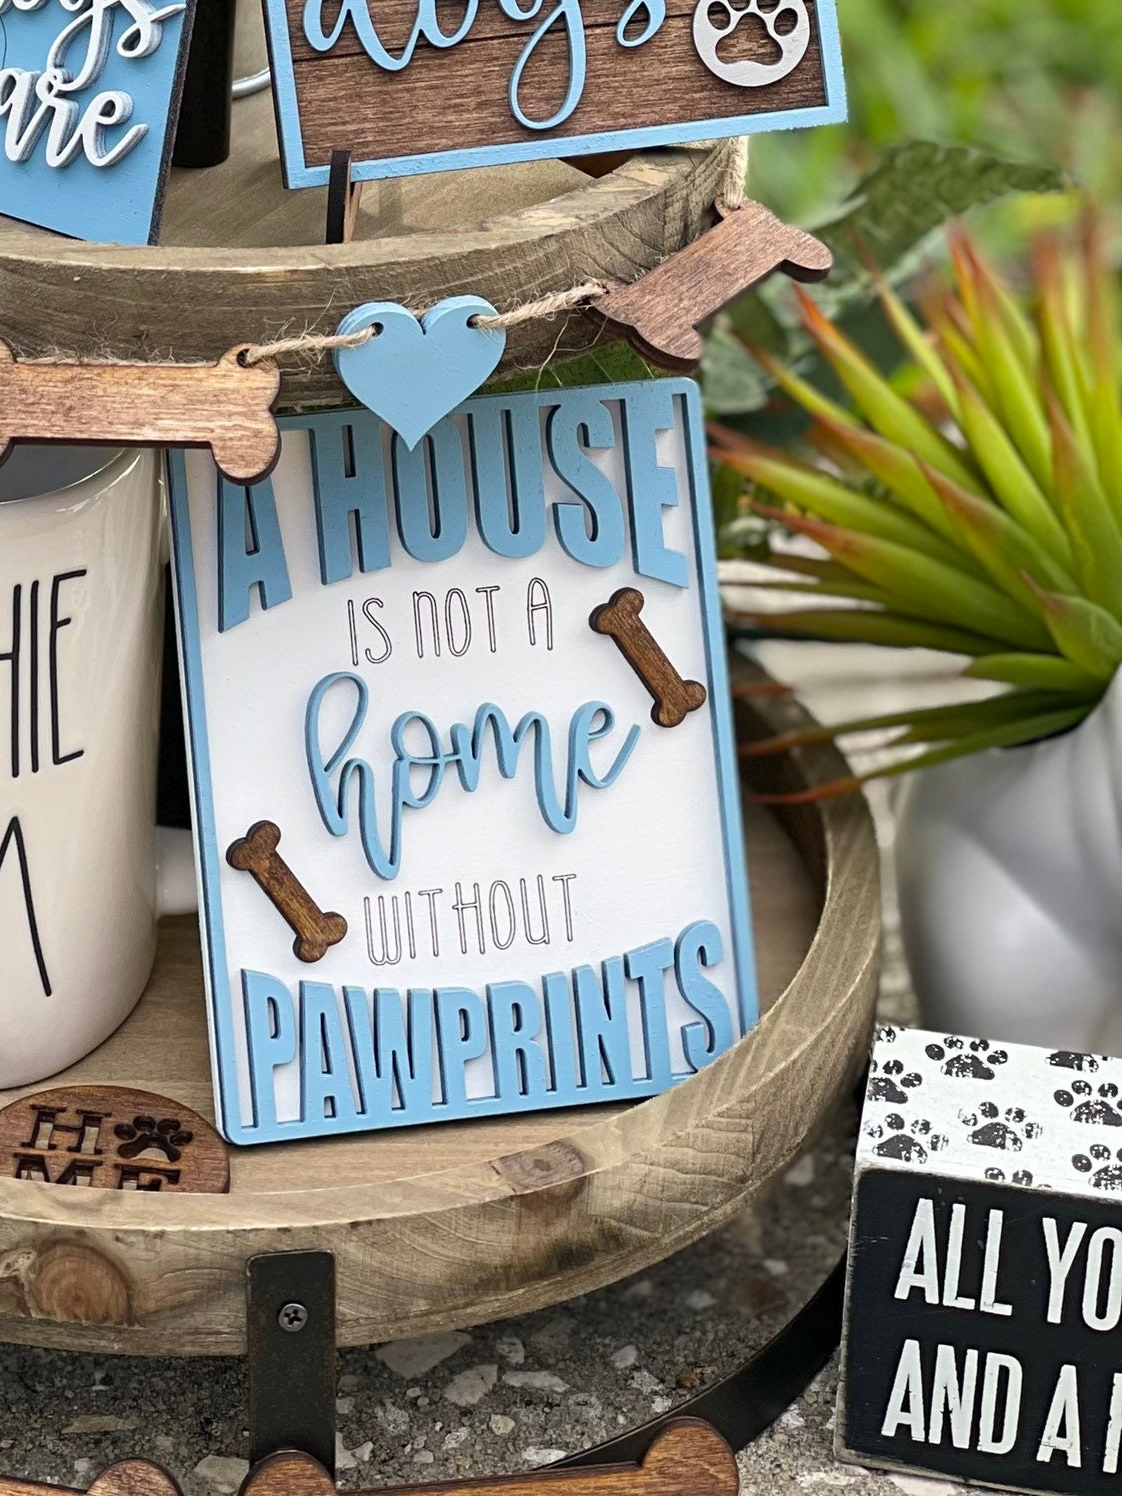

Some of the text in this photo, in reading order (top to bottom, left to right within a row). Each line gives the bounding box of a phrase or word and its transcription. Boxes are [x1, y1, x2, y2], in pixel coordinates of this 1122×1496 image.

[217, 393, 689, 633] A HOUSE
[347, 597, 392, 666] IS
[526, 577, 554, 651] A
[304, 671, 641, 880] home
[362, 873, 577, 967] WITHOUT
[242, 919, 734, 1129] PAWPRINTS
[894, 1198, 1012, 1316] ALL
[881, 1339, 1023, 1455] AND
[1036, 1364, 1082, 1469] A
